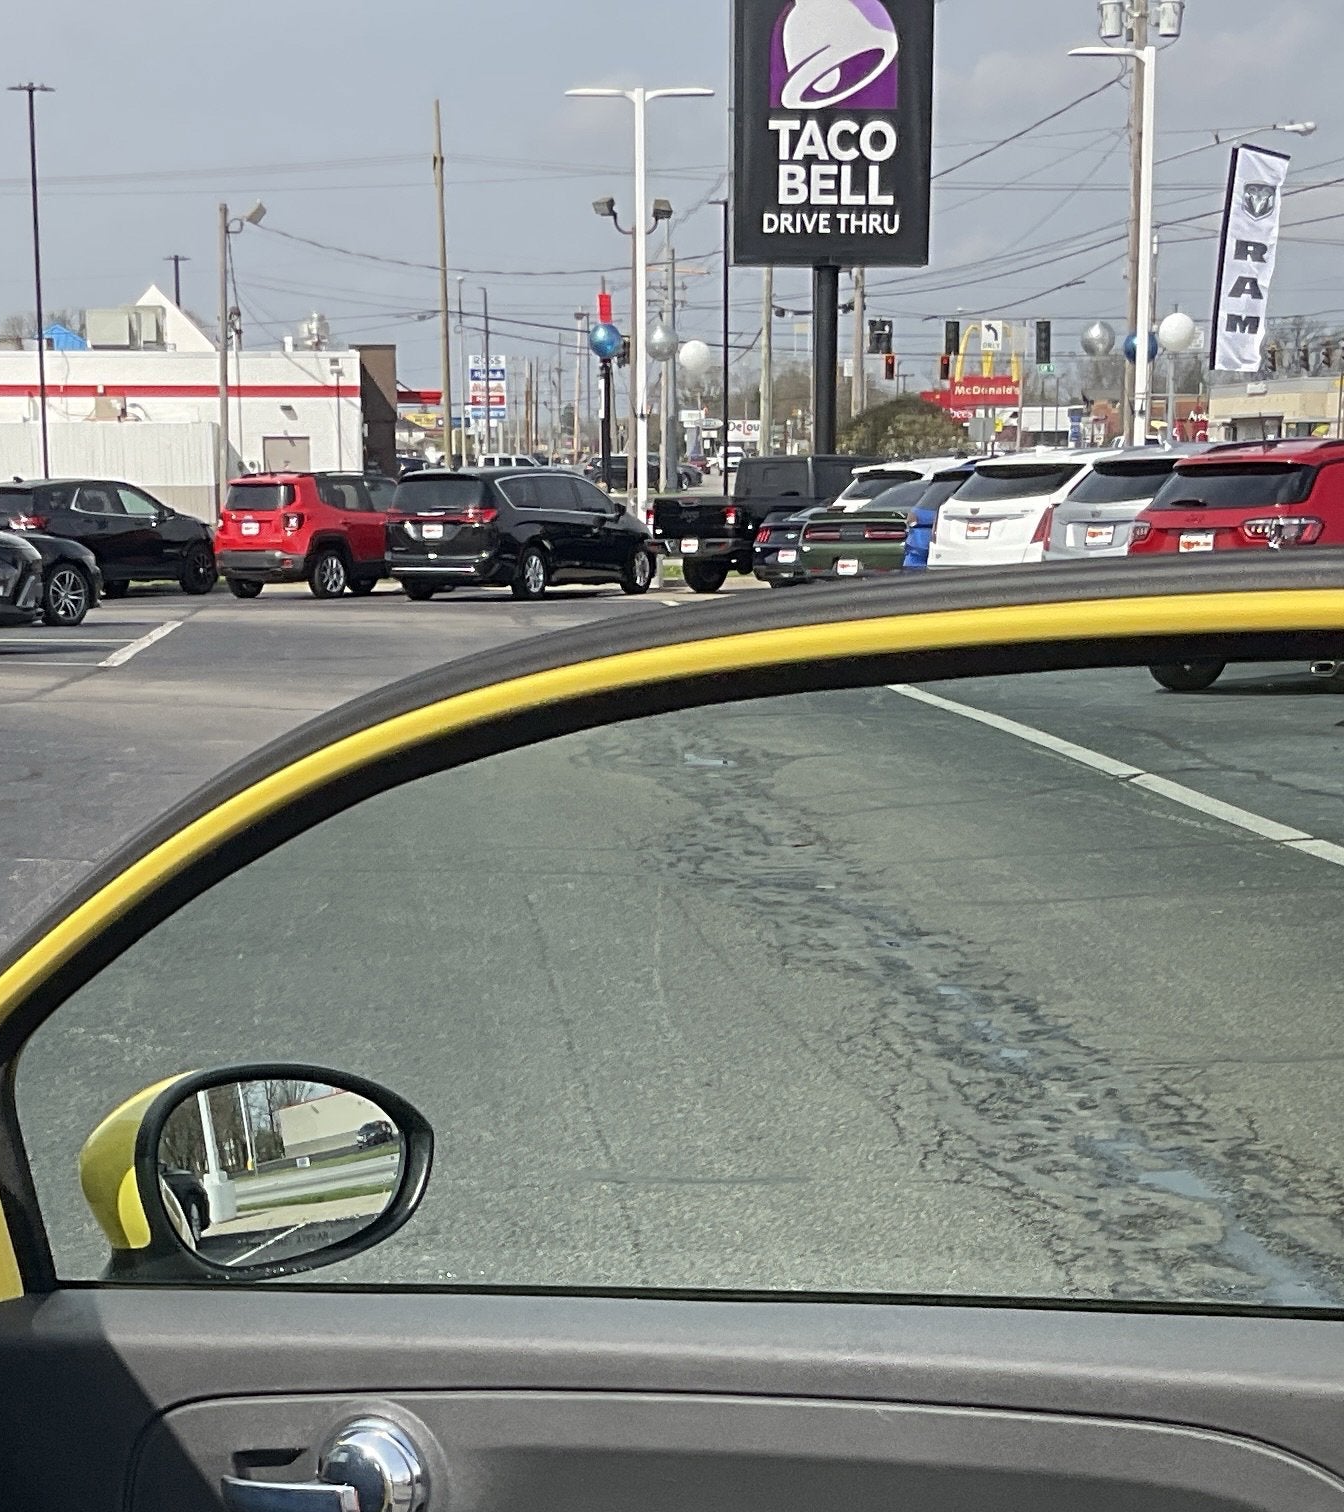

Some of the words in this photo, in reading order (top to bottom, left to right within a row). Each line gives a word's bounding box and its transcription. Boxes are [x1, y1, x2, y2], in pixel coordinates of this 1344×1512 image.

[768, 119, 897, 162] TACO
[777, 164, 895, 206] BELL
[762, 213, 831, 234] DRIVE
[836, 213, 900, 234] THRU
[1225, 239, 1270, 335] RAM
